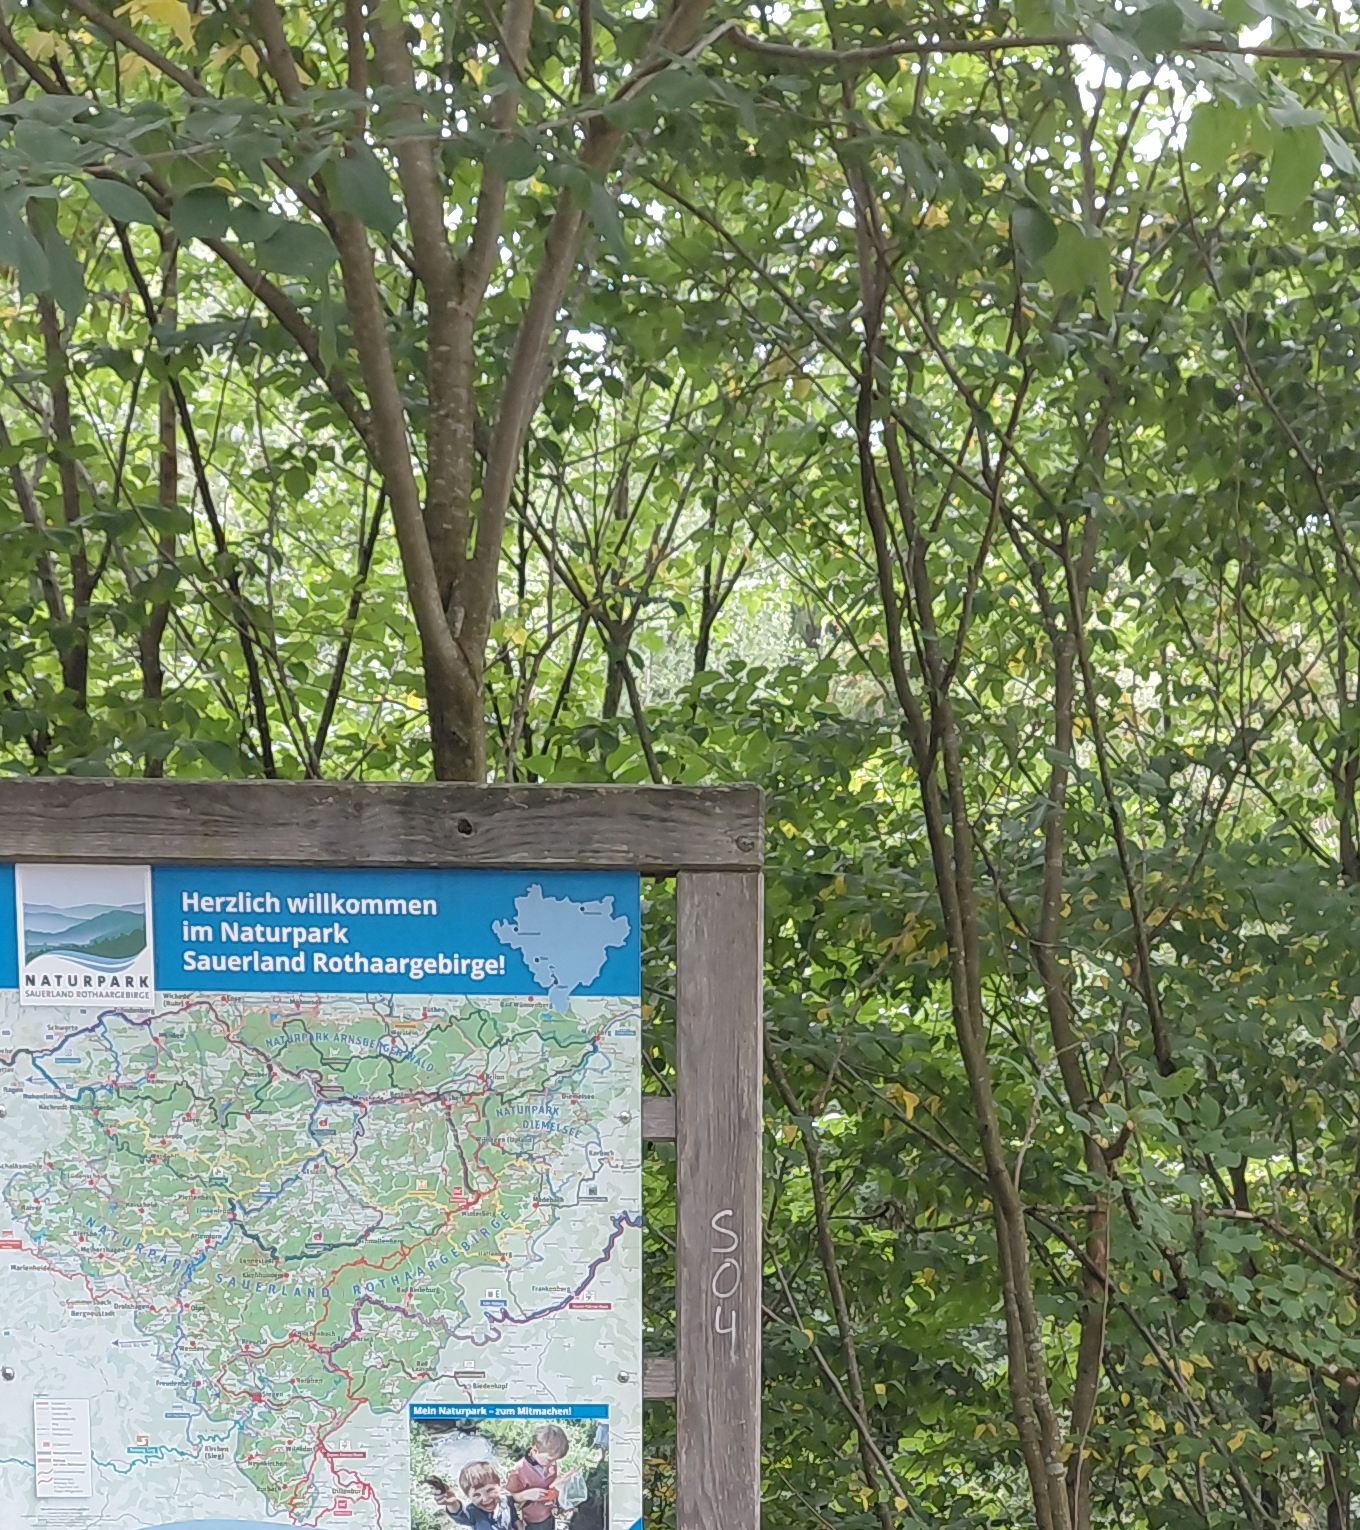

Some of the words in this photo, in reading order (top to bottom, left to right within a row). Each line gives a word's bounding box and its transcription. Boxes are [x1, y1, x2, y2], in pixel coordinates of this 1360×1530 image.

[181, 891, 279, 913] Herzlich
[287, 892, 437, 915] willkommen
[181, 921, 213, 942] im
[220, 923, 348, 946] Naturpark
[183, 951, 305, 972] Sauerland
[313, 954, 506, 979] Rothaargebirge!
[25, 974, 149, 988] NATURPARK
[25, 990, 74, 998] SAUERLAND
[76, 990, 149, 999] ROTHAARGEBIRGE
[413, 1407, 436, 1415] Mein
[439, 1407, 487, 1417] Naturpark
[517, 1407, 572, 1415] Mitmachen!
